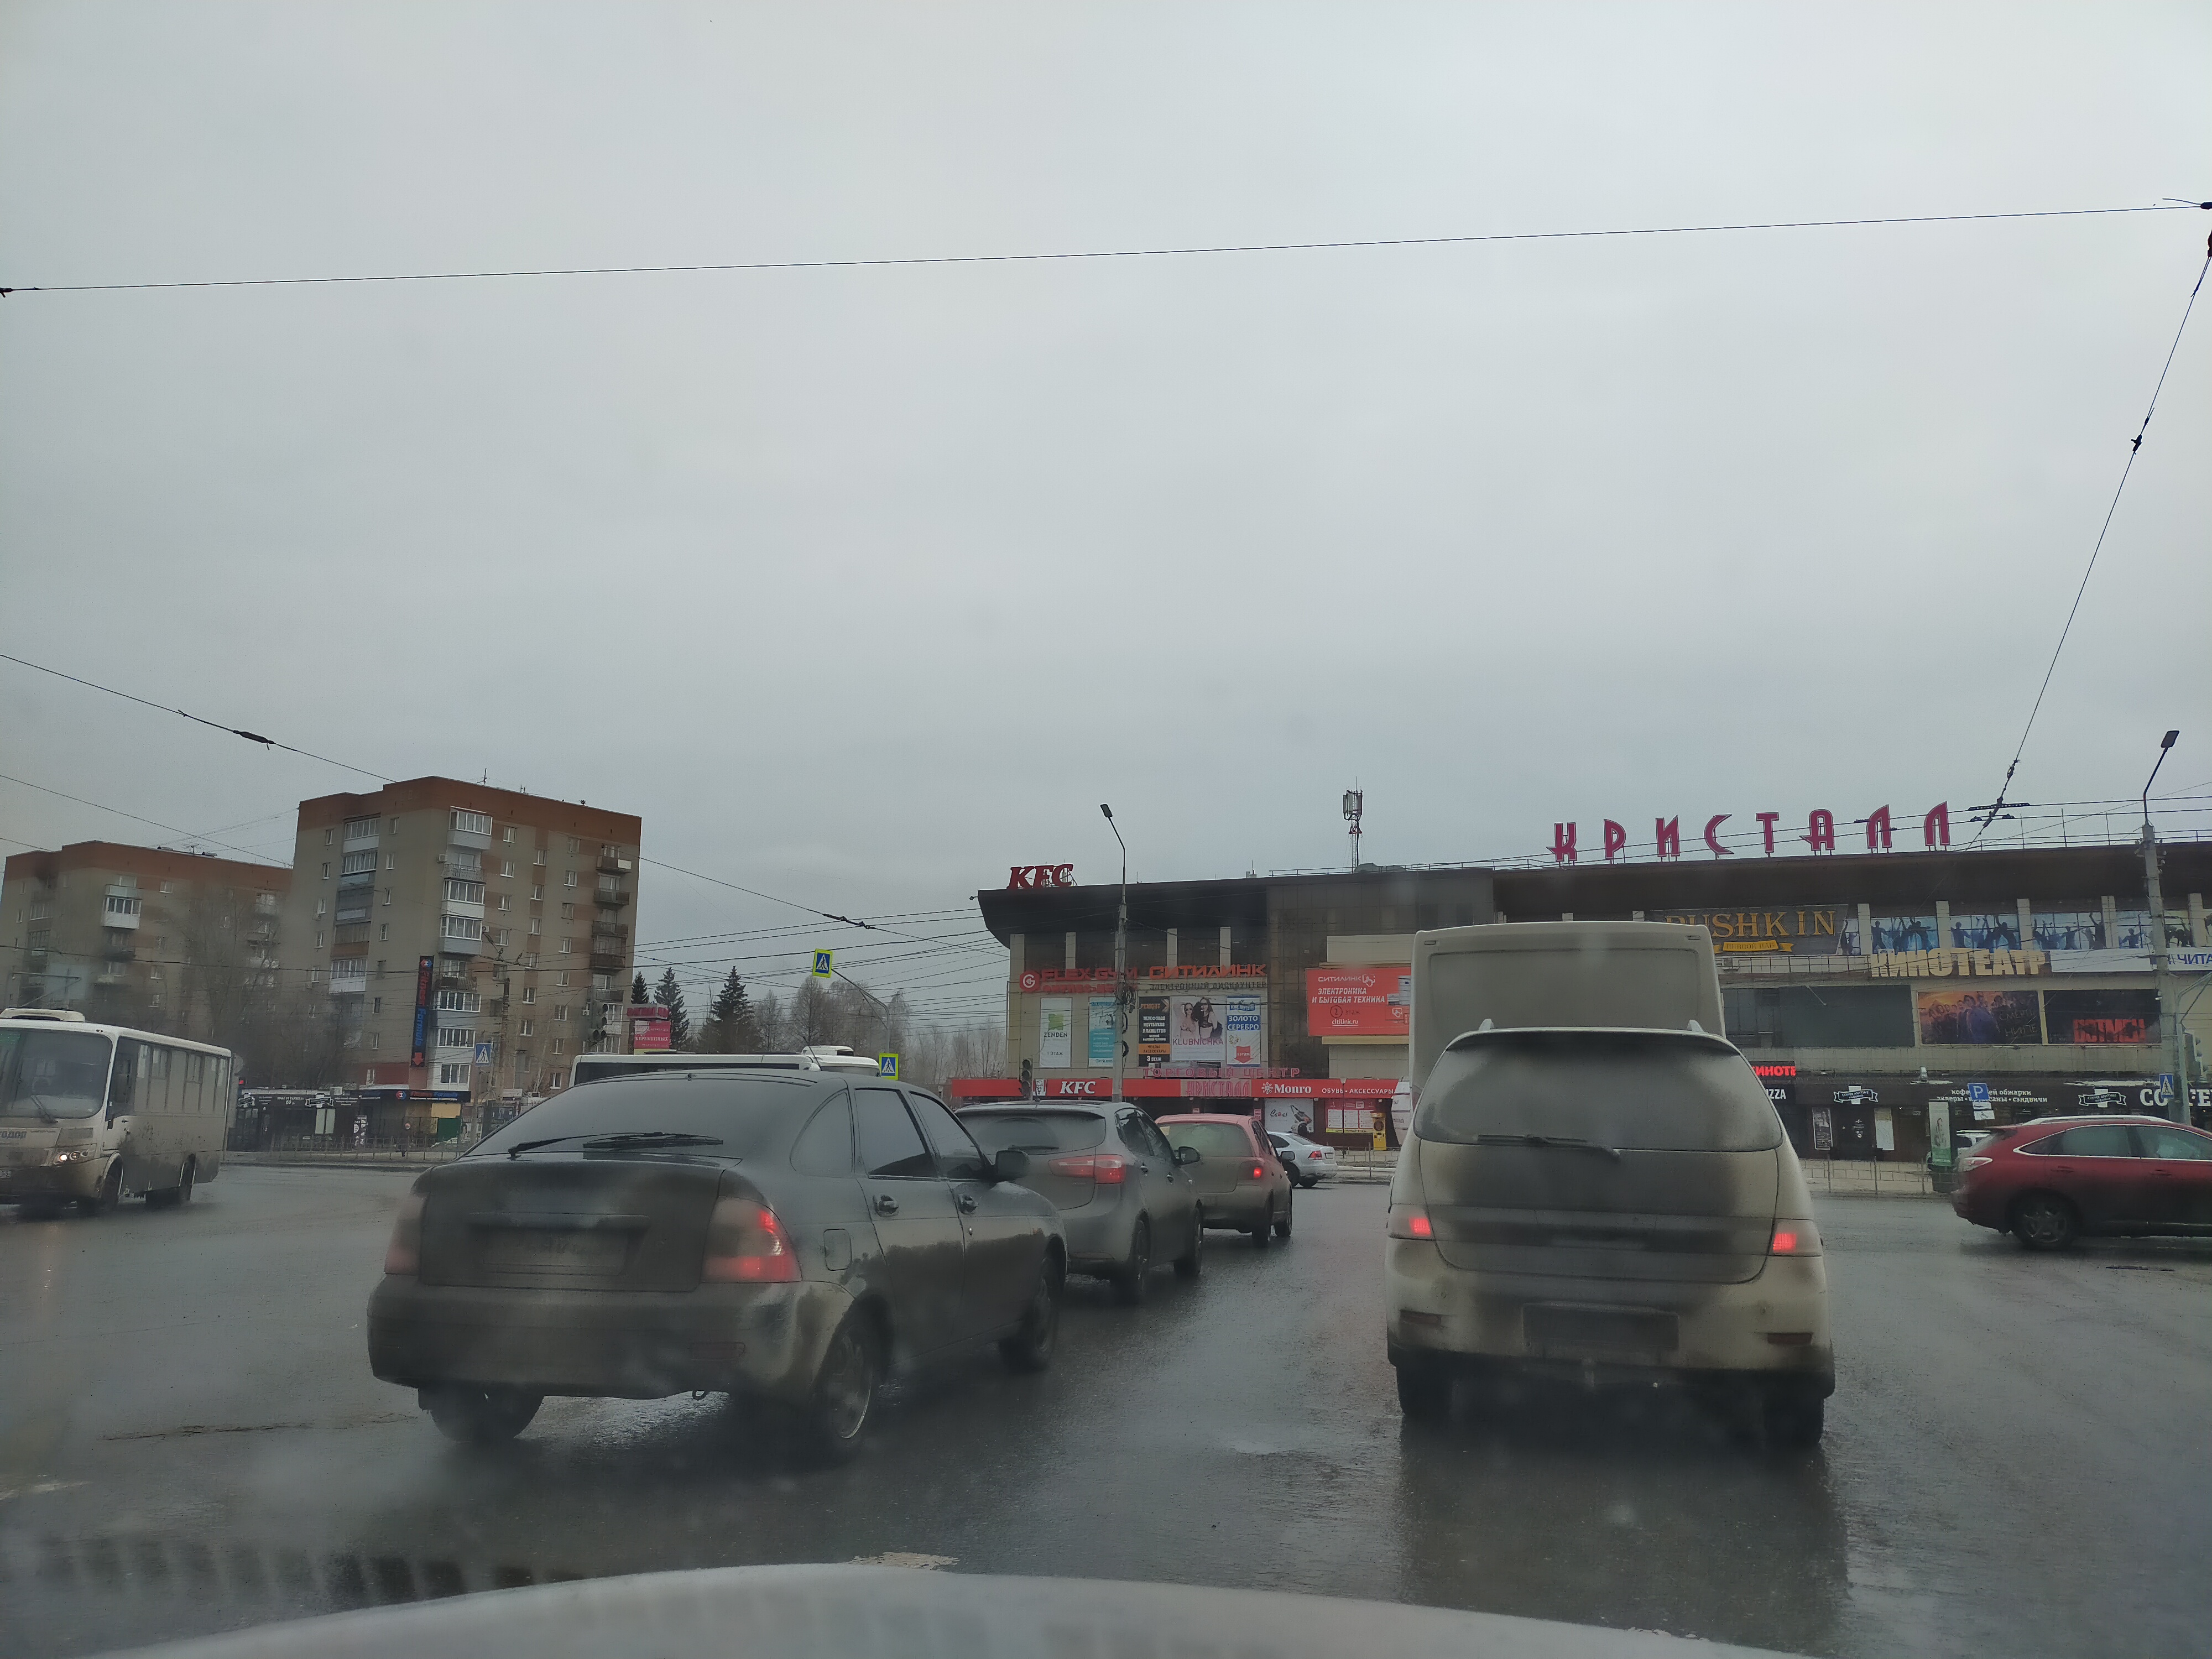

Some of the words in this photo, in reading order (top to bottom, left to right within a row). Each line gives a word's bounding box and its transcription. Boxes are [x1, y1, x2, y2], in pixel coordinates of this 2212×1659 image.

[1546, 801, 1950, 862] КРИСТАЛЛ
[1006, 863, 1073, 889] KFC
[1871, 947, 2046, 977] КИНОТЕАТР
[1042, 968, 1091, 981] FLEX
[1149, 964, 1266, 979] СИТИЛИНК
[1150, 982, 1209, 990] ЭЛЕКТРОННЫЙ
[1144, 1066, 1234, 1077] ТОРГОВЫЙ
[1244, 1067, 1300, 1077] ЦЕНТР
[1060, 1081, 1095, 1094] KFC
[1186, 1081, 1251, 1097] КРИСТАЛЛ
[1274, 1083, 1312, 1094] Monro
[1951, 1088, 1970, 1097] кофе
